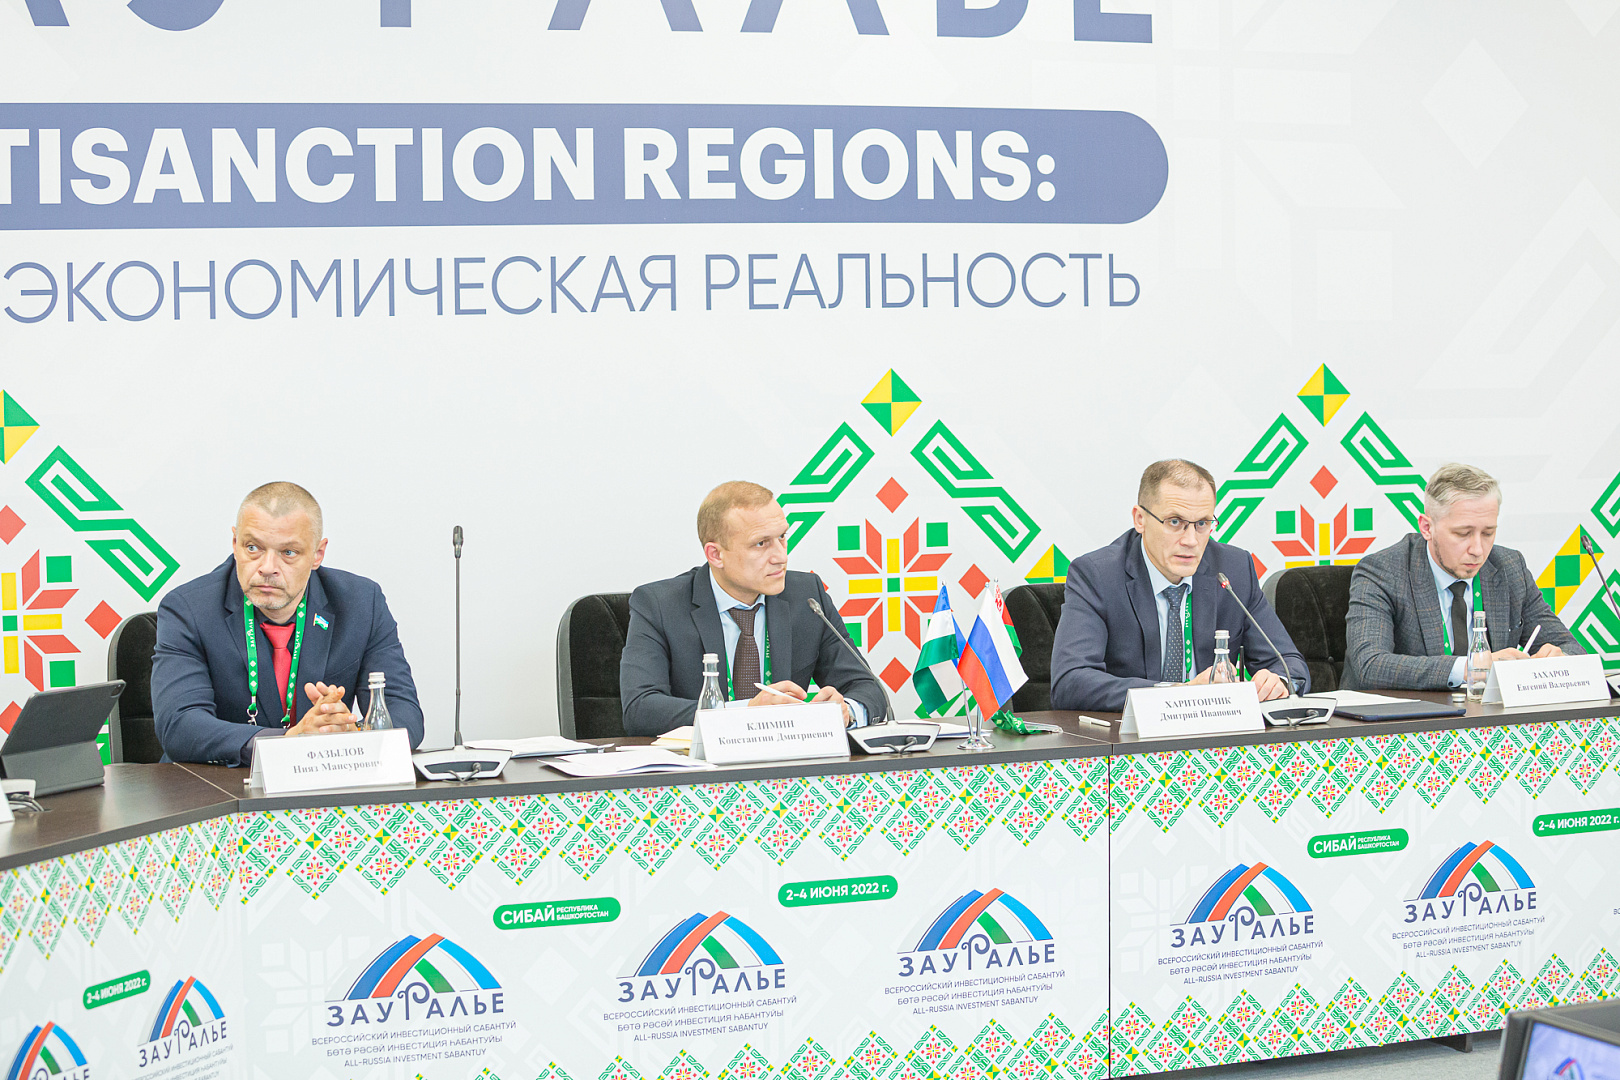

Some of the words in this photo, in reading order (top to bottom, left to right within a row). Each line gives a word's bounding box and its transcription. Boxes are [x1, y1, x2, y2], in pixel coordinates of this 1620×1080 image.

[623, 126, 1056, 202] REGIONS:
[3, 254, 677, 323] ЭКОНОМИЧЕСКАЯ
[705, 252, 1140, 311] РЕАЛЬНОСТЬ
[1532, 670, 1570, 679] ЗАХАРОВ
[1517, 682, 1547, 691] Евгений
[1549, 680, 1590, 689] Валерьевич
[1165, 697, 1231, 708] ХАРИТОНЧИК
[1160, 710, 1198, 722] Дмитрий
[1200, 709, 1242, 718] Иванович
[747, 720, 794, 731] КЛИМИН
[719, 736, 774, 745] Константин
[777, 731, 833, 742] Дмитриевич
[307, 747, 364, 760] ФАЗЫЛОВ
[293, 765, 318, 774] Нияз
[1558, 817, 1587, 828] ИЮНЯ
[1590, 814, 1611, 826] 2022
[1314, 836, 1356, 853] СИБАЙ
[1358, 835, 1391, 843] РЕСПУБЛИКА
[1358, 841, 1399, 849] БАШКОРТОСТАН
[810, 885, 848, 898] ИЮНЯ
[851, 883, 879, 895] 2022
[882, 884, 889, 893] г.
[557, 904, 598, 913] РЕСПУБЛИКА
[1404, 883, 1536, 923] ЗАУРАЛЬЕ
[501, 905, 555, 924] СИБАЙ
[557, 911, 608, 920] БАШКОРТОСТАН
[1171, 905, 1313, 948] ЗАУРАЛЬЕ
[1392, 926, 1449, 939] ВСЕРОССИЙСКИЙ
[1451, 919, 1512, 932] ИНВЕСТИЦИОННЫЙ
[1513, 915, 1545, 926] САБАНТУЙ
[1449, 933, 1493, 944] ИНВЕСТИЦИЯ
[898, 934, 1055, 977] ЗАУРАЛЬЕ
[1158, 952, 1220, 965] ВСЕРОССИЙСКИЙ
[1222, 945, 1287, 958] ИНВЕСТИЦИОННЫЙ
[1289, 941, 1323, 951] САБАНТУЙ
[1416, 948, 1451, 958] ALL-RUSSIA
[1452, 944, 1489, 954] INVESTMENT
[1491, 940, 1522, 950] SABANTUY
[1219, 958, 1267, 970] ИНВЕСТИЦИЯ
[617, 958, 785, 1002] ЗАУРАЛЬЕ
[885, 982, 952, 994] ВСЕРОССИЙСКИЙ
[954, 974, 1025, 988] ИНВЕСТИЦИОННЫЙ
[1027, 970, 1065, 981] САБАНТУЙ
[1184, 974, 1221, 984] ALL-RUSSIA
[1223, 970, 1263, 980] INVESTMENT
[1265, 966, 1298, 975] SABANTUY
[100, 983, 123, 999] ИЮНЯ
[124, 977, 141, 992] 2022
[951, 988, 1004, 999] ИНВЕСТИЦИЯ
[326, 981, 504, 1027] ЗАУРАЛЬЕ
[603, 1006, 676, 1020] ВСЕРОССИЙСКИЙ
[678, 999, 754, 1014] ИНВЕСТИЦИОННЫЙ
[756, 995, 797, 1007] САБАНТУЙ
[913, 1004, 954, 1015] ALL-RUSSIA
[956, 1000, 999, 1010] INVESTMENT
[1001, 996, 1038, 1006] SABANTUY
[675, 1015, 731, 1026] ИНВЕСТИЦИЯ
[312, 1030, 388, 1045] ВСЕРОССИЙСКИЙ
[391, 1024, 471, 1039] ИНВЕСТИЦИОННЫЙ
[473, 1020, 516, 1032] САБАНТУЙ
[634, 1032, 678, 1042] ALL-RUSSIA
[680, 1027, 726, 1037] INVESTMENT
[729, 1022, 768, 1032] SABANTUY
[139, 1020, 227, 1067] ЗАУРАЛЬЕ
[387, 1040, 447, 1051] ИНВЕСТИЦИЯ
[344, 1056, 391, 1067] ALL-RUSSIA
[393, 1052, 442, 1063] INVESTMENT
[444, 1048, 486, 1058] SABANTUY
